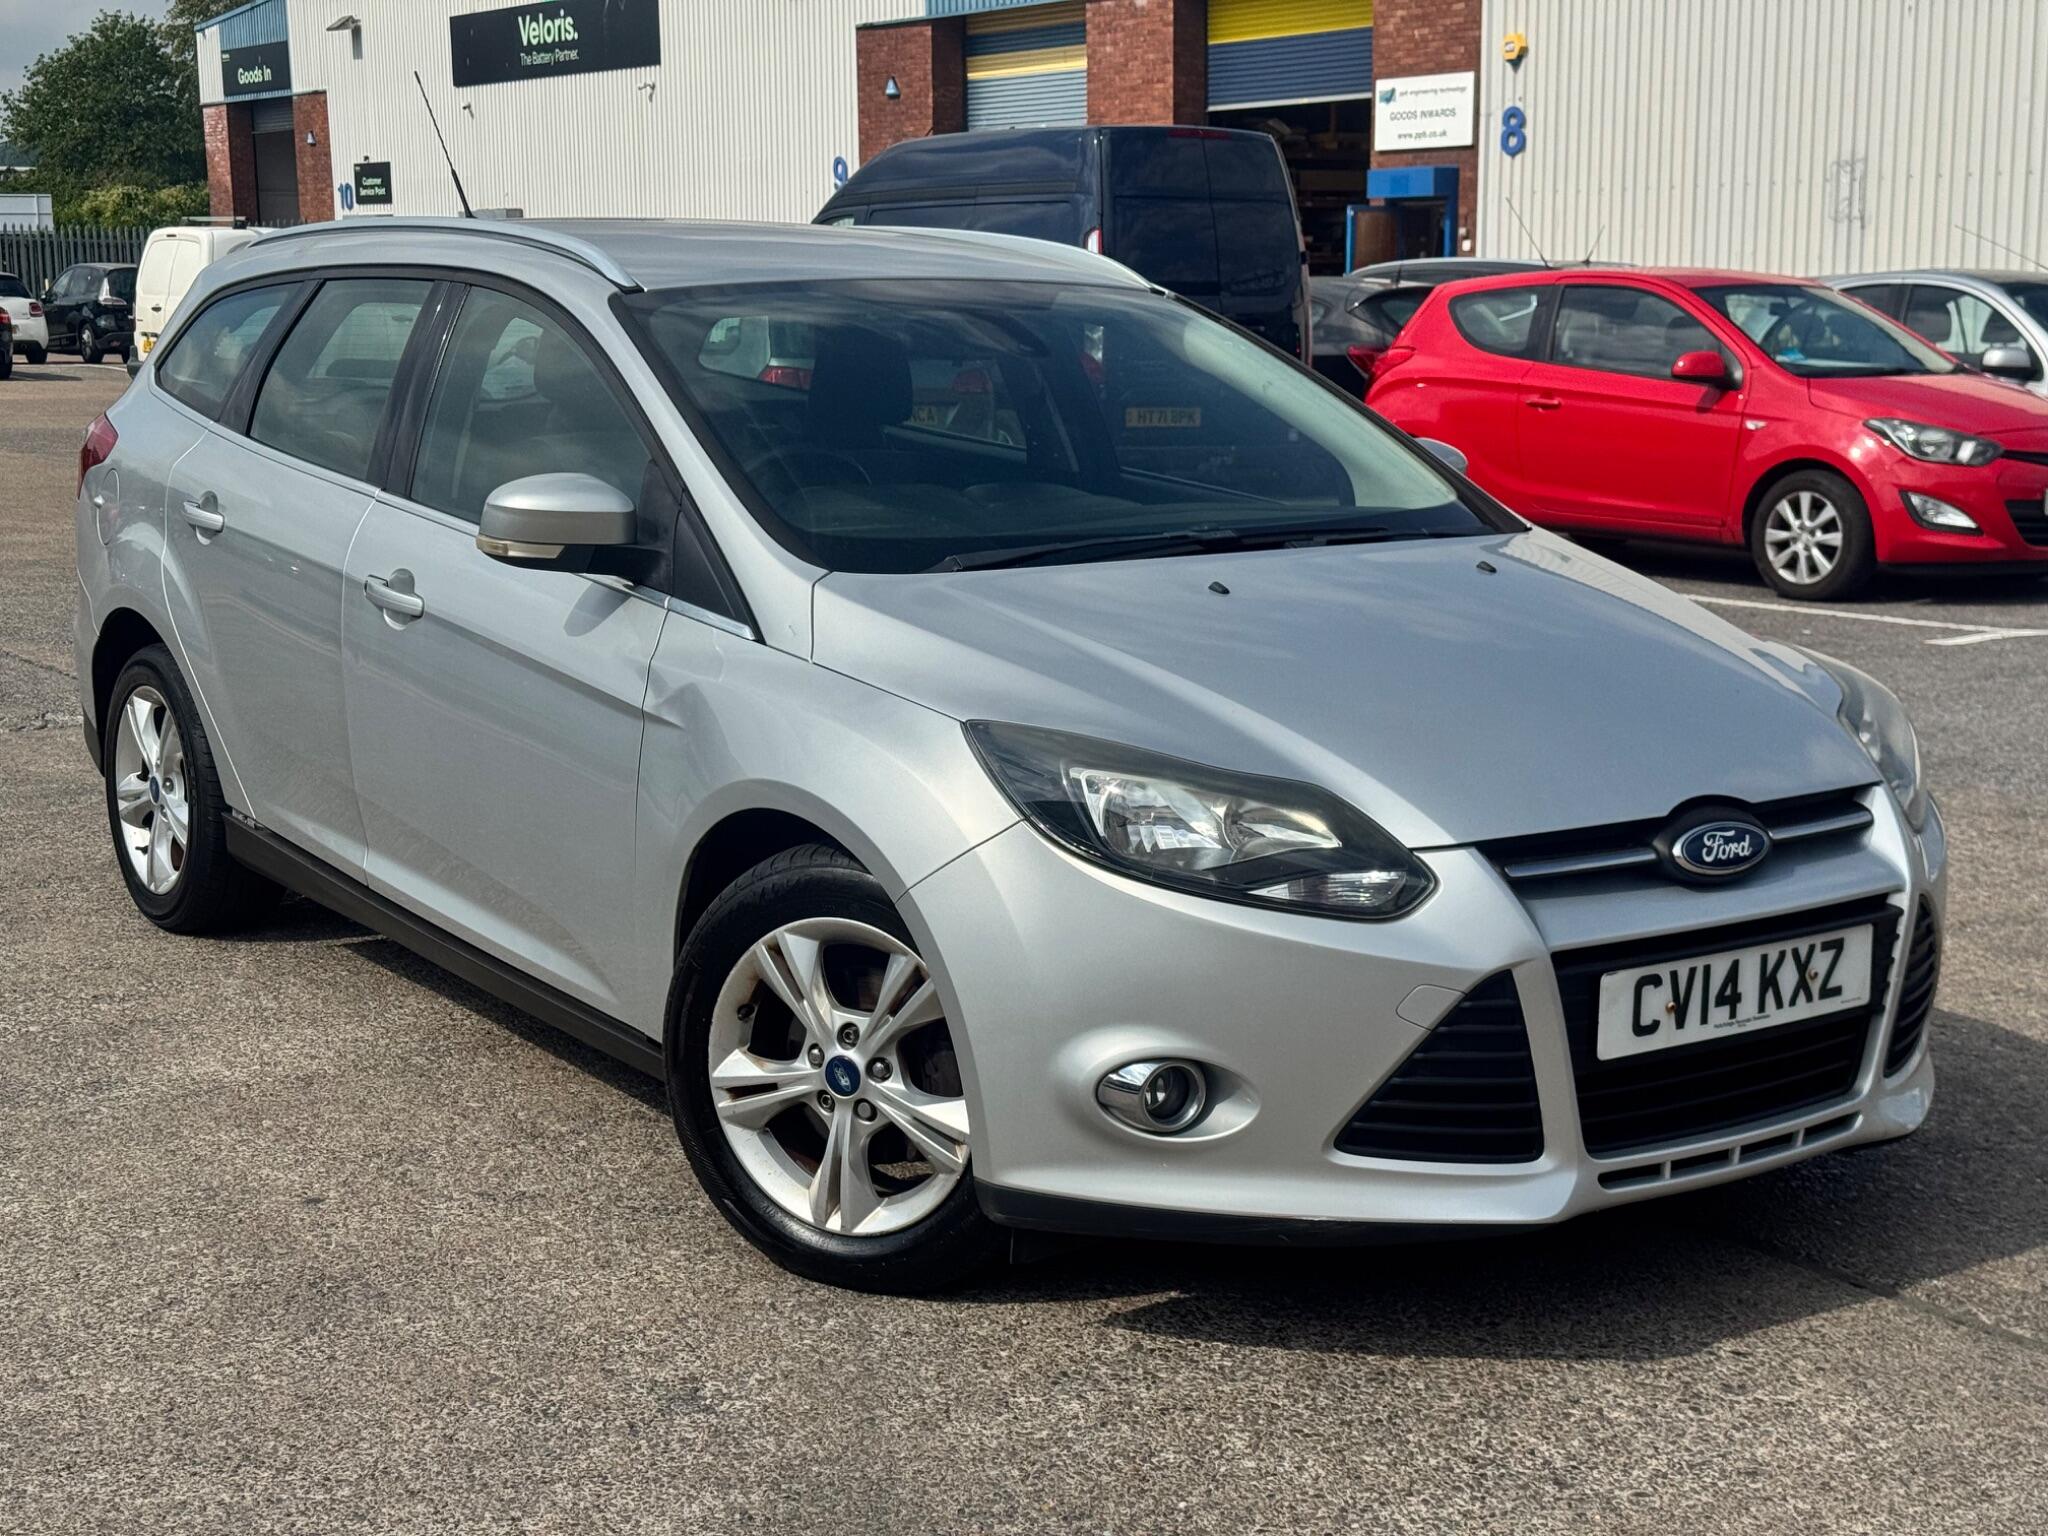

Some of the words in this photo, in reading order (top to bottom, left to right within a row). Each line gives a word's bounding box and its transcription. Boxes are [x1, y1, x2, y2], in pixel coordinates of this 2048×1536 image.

[518, 8, 579, 47] Veloris.
[237, 66, 263, 85] Goods
[263, 65, 272, 81] In
[520, 52, 532, 66] The
[532, 51, 555, 66] Battery
[1501, 106, 1526, 158] 8
[833, 156, 849, 191] 9
[338, 183, 354, 211] 10
[1702, 830, 1753, 863] Ford
[1632, 958, 1742, 1038] CV14
[1757, 937, 1845, 1014] KXZ
